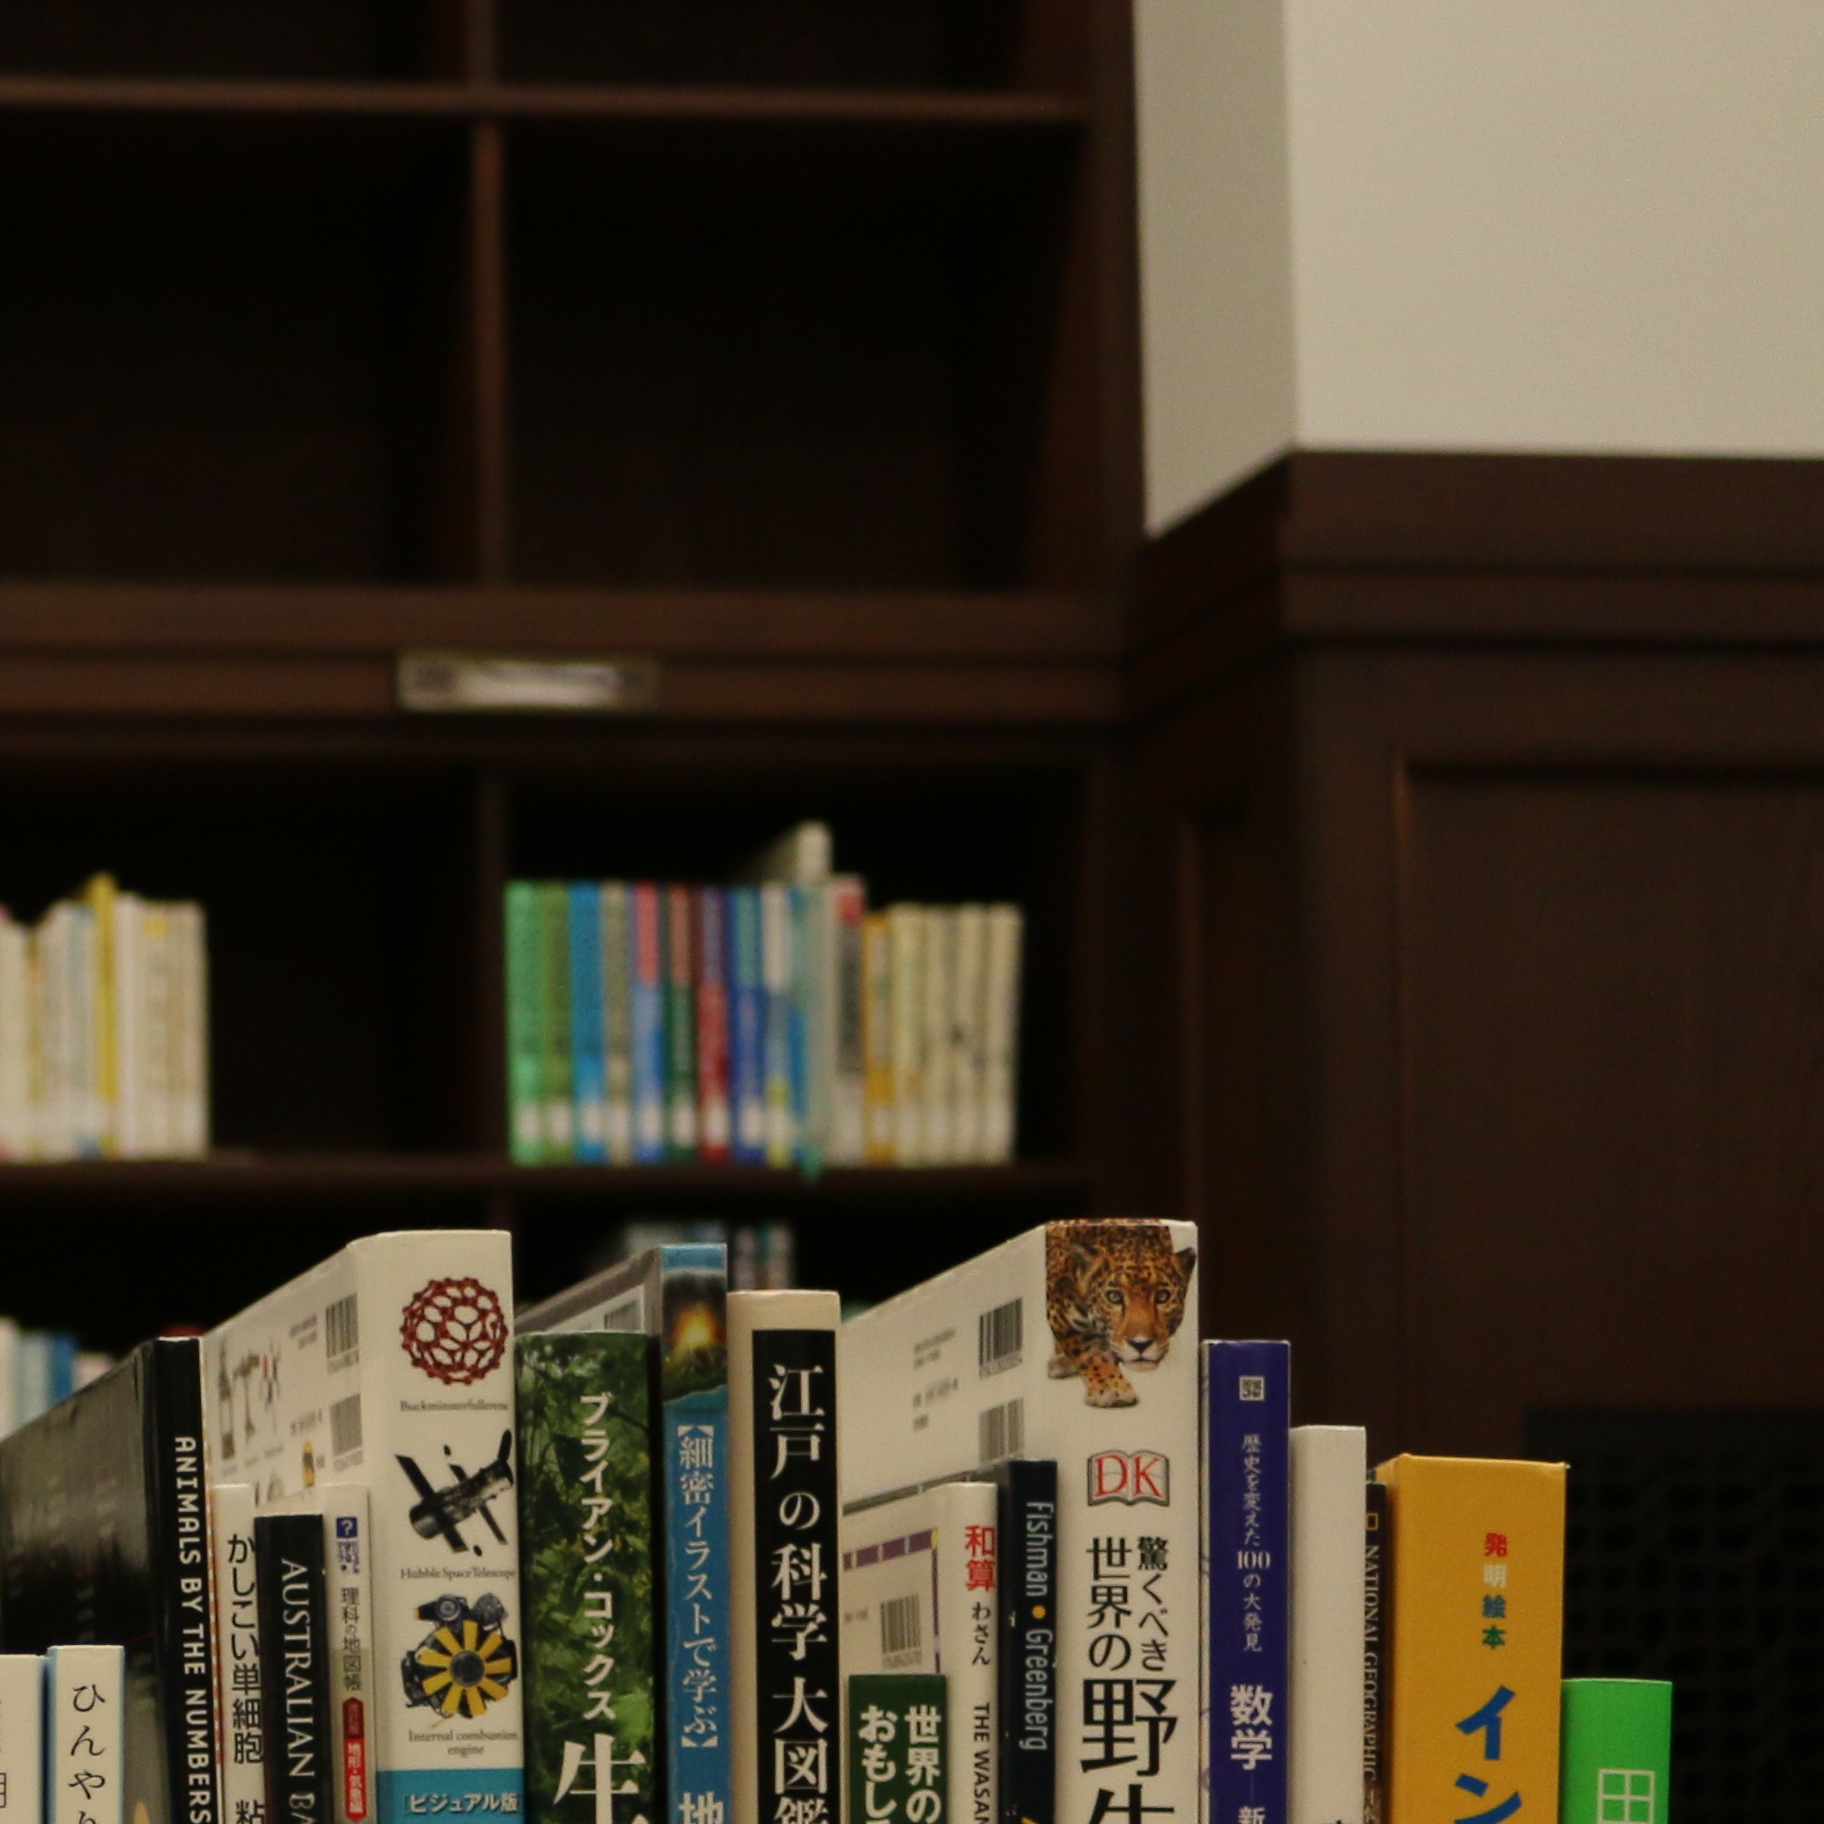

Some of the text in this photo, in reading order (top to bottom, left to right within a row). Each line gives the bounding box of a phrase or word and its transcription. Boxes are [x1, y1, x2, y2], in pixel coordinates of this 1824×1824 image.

[1095, 1455, 1164, 1499] DK
[400, 1568, 440, 1578] Hubble
[580, 1394, 616, 1719] ブライアン・コックス
[676, 1425, 719, 1748] 【細密イラストで学ぶ】
[965, 1524, 996, 1592] 和算
[1086, 1536, 1132, 1671] 世界の
[1137, 1535, 1169, 1671] 驚くべき
[1236, 1434, 1271, 1653] 歴史を変えた100の大発見
[1481, 1532, 1509, 1649] 発明絵本
[174, 1436, 211, 1824] ANIMALS BY THE NUMBERS
[282, 1559, 314, 1777] AUSTRALIAN
[971, 1602, 991, 1667] わさん
[1019, 1501, 1055, 1751] Fishman Greenberg
[408, 1731, 517, 1741] Internal combustion
[973, 1702, 990, 1742] THE
[1229, 1684, 1273, 1771] 数学
